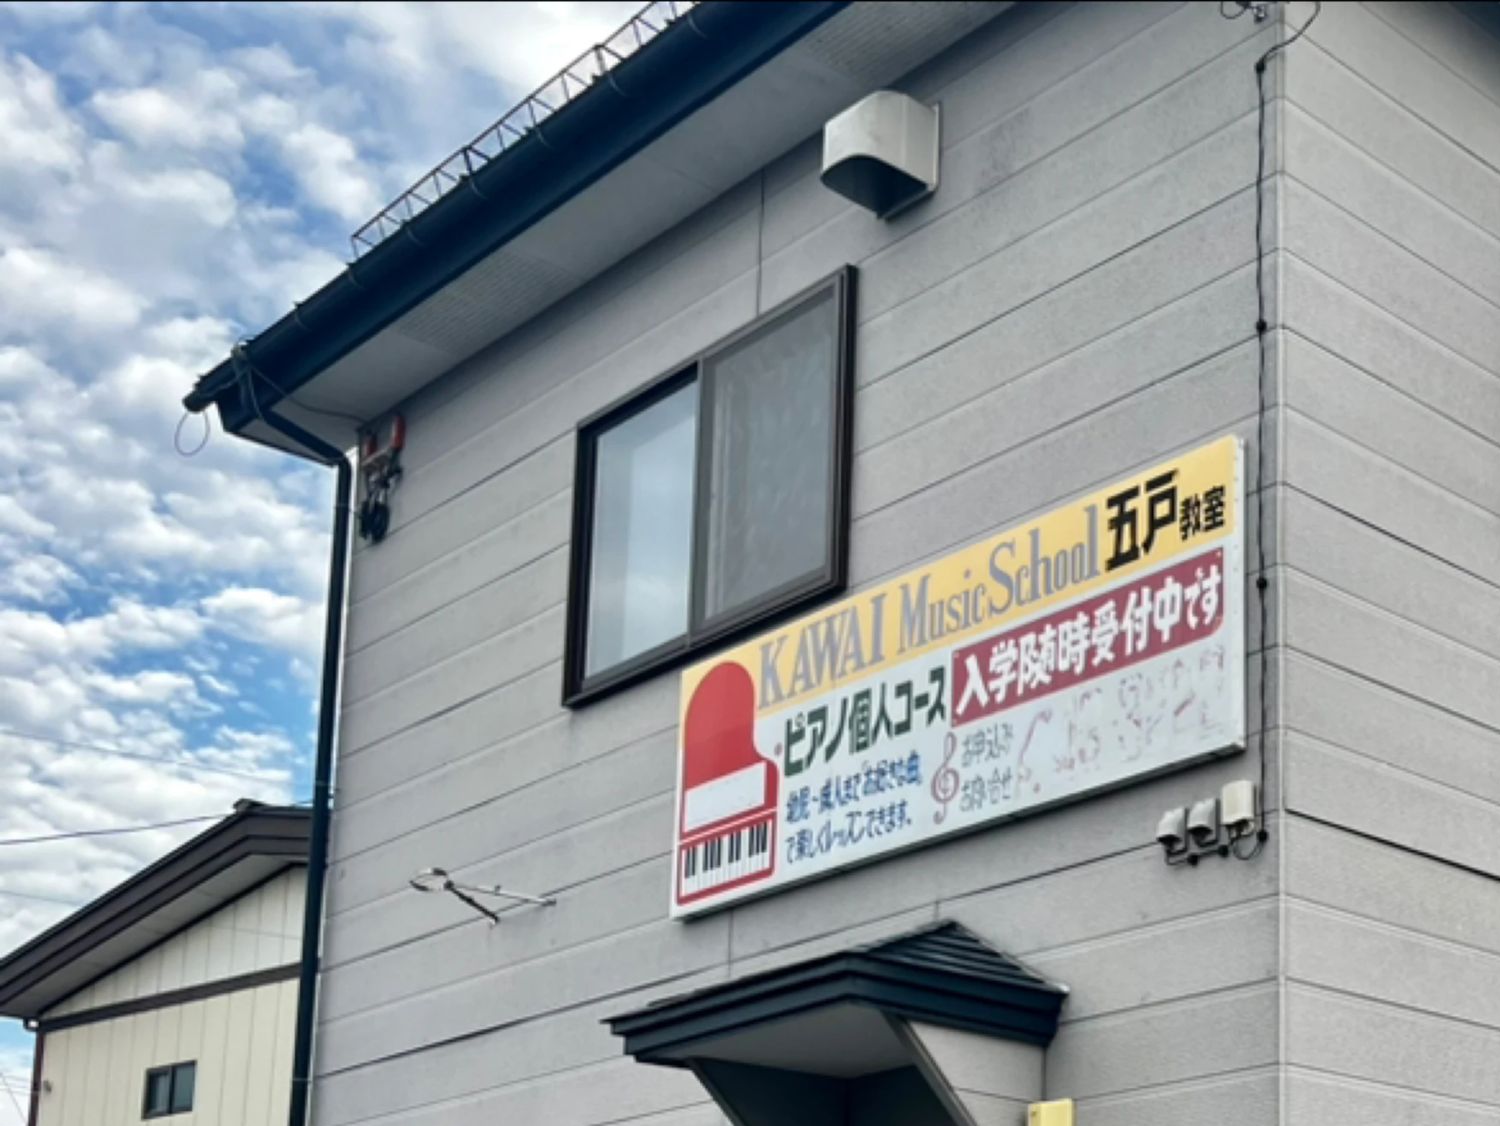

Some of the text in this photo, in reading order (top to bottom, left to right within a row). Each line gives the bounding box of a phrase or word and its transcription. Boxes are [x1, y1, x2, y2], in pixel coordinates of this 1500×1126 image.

[758, 505, 1101, 709] KAWAI Music School
[956, 566, 1222, 715] 入学随時受付中です
[783, 666, 946, 776] ピアノ個人コース
